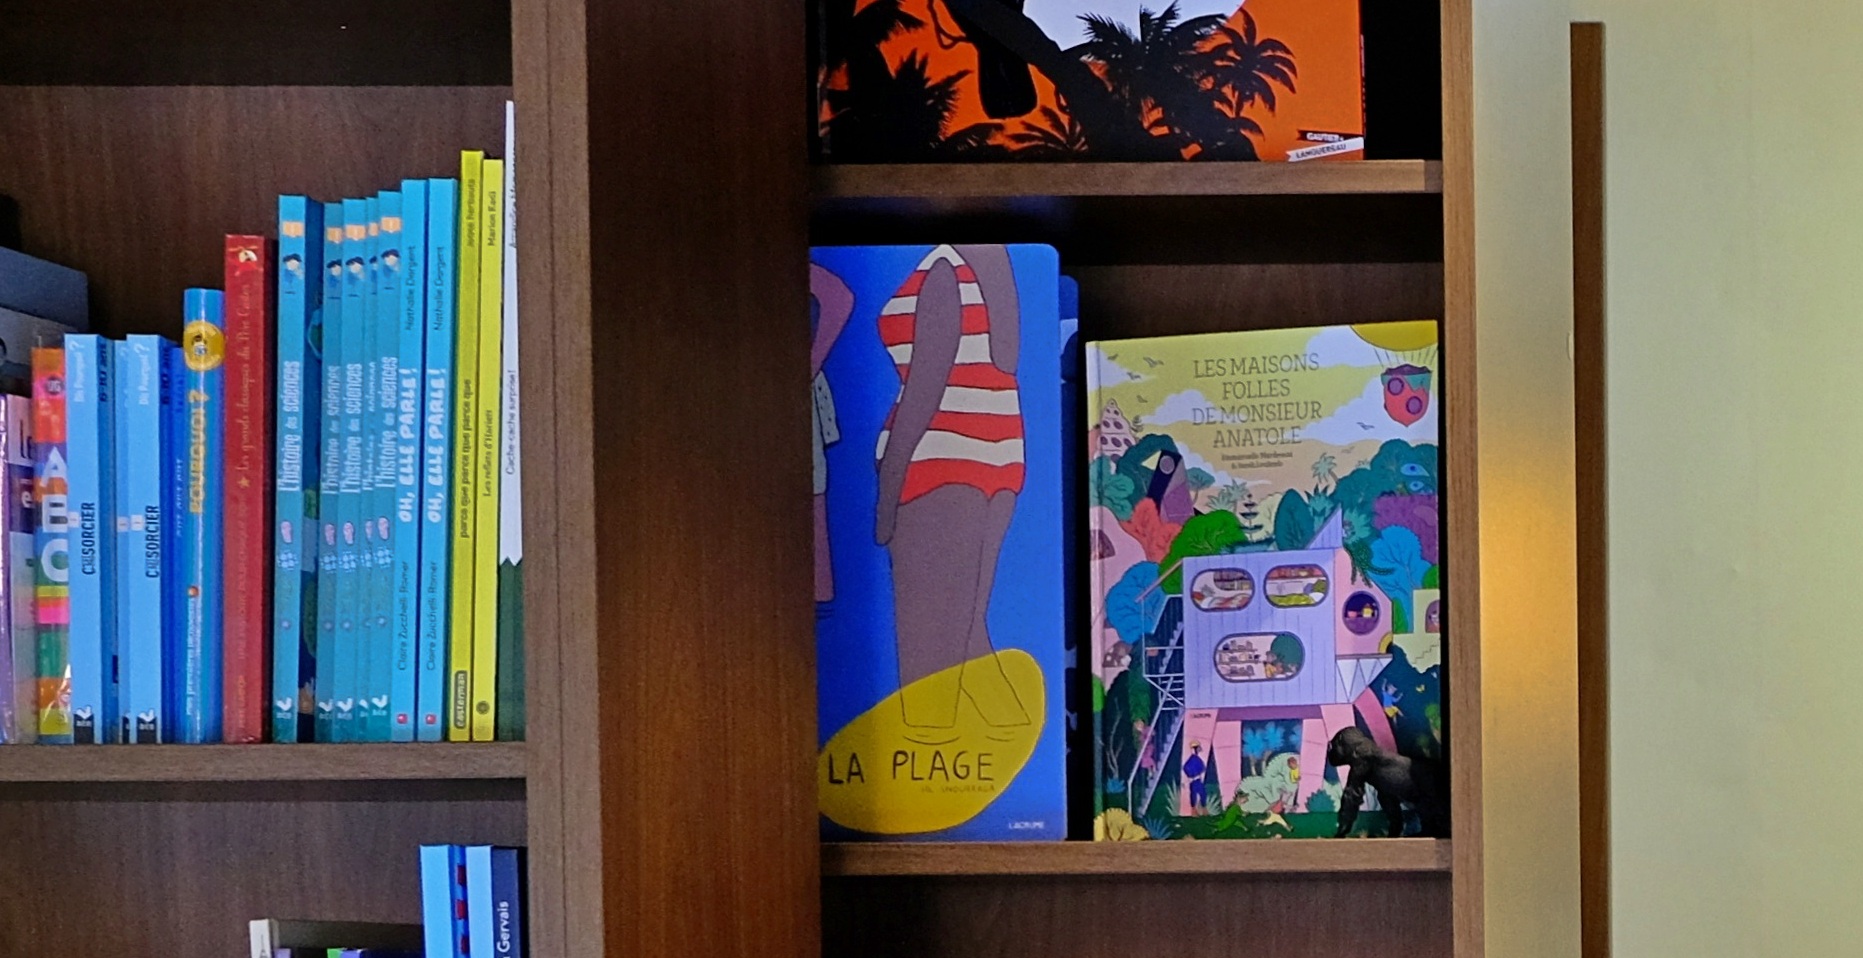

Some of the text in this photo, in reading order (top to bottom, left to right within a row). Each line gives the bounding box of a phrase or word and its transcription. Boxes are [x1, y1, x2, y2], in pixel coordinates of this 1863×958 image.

[486, 213, 497, 246] Marion
[380, 355, 398, 409] sciences
[1193, 353, 1320, 378] LES MAISONS
[281, 360, 301, 413] sciences
[342, 362, 362, 415] sciences
[1223, 379, 1292, 400] FOLLES
[1192, 401, 1323, 425] DE MONSIEUR
[1213, 426, 1303, 448] ANATOLE
[398, 445, 416, 486] ELLE
[427, 445, 446, 486] ELLE
[398, 493, 416, 523] OH,
[427, 493, 447, 523] OH,
[455, 672, 466, 728] casterman
[827, 750, 995, 785] LA PLAGE
[496, 901, 511, 953] Gervais
